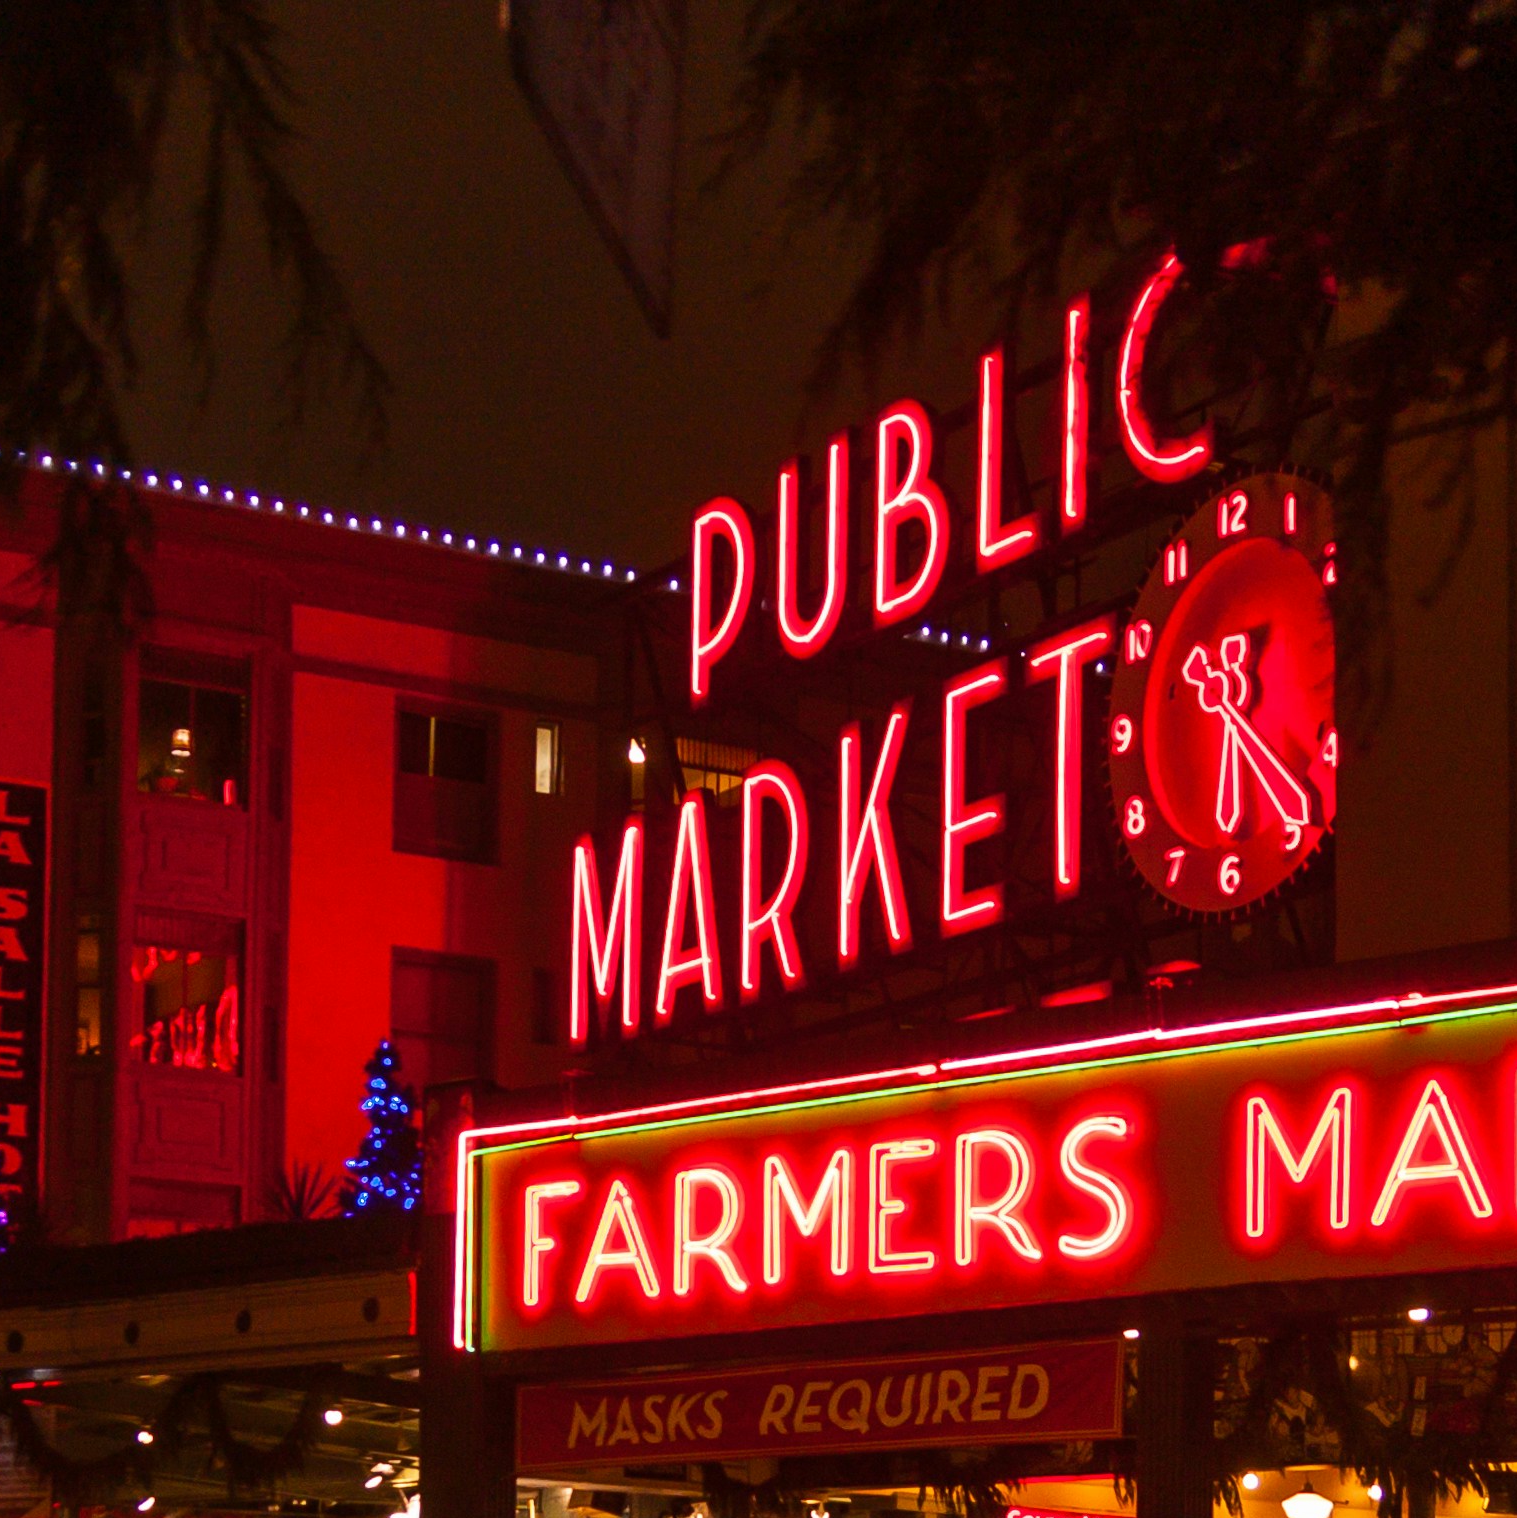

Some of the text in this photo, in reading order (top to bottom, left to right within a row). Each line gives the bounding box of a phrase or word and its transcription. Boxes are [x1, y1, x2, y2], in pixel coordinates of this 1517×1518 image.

[691, 252, 1215, 703] PUBLIC
[1218, 490, 1248, 538] 12
[1283, 492, 1297, 535] 1
[1164, 540, 1188, 585] 11
[1125, 619, 1152, 664] 10
[1111, 714, 1132, 755] 9
[1321, 726, 1338, 768] 4
[570, 613, 1114, 1046] MARKET
[1123, 796, 1146, 839] 8
[1164, 847, 1186, 887] 7
[1218, 853, 1241, 895] 6
[521, 1115, 1129, 1307] FARMERS
[566, 1364, 1051, 1451] MASKS REQUIRED
